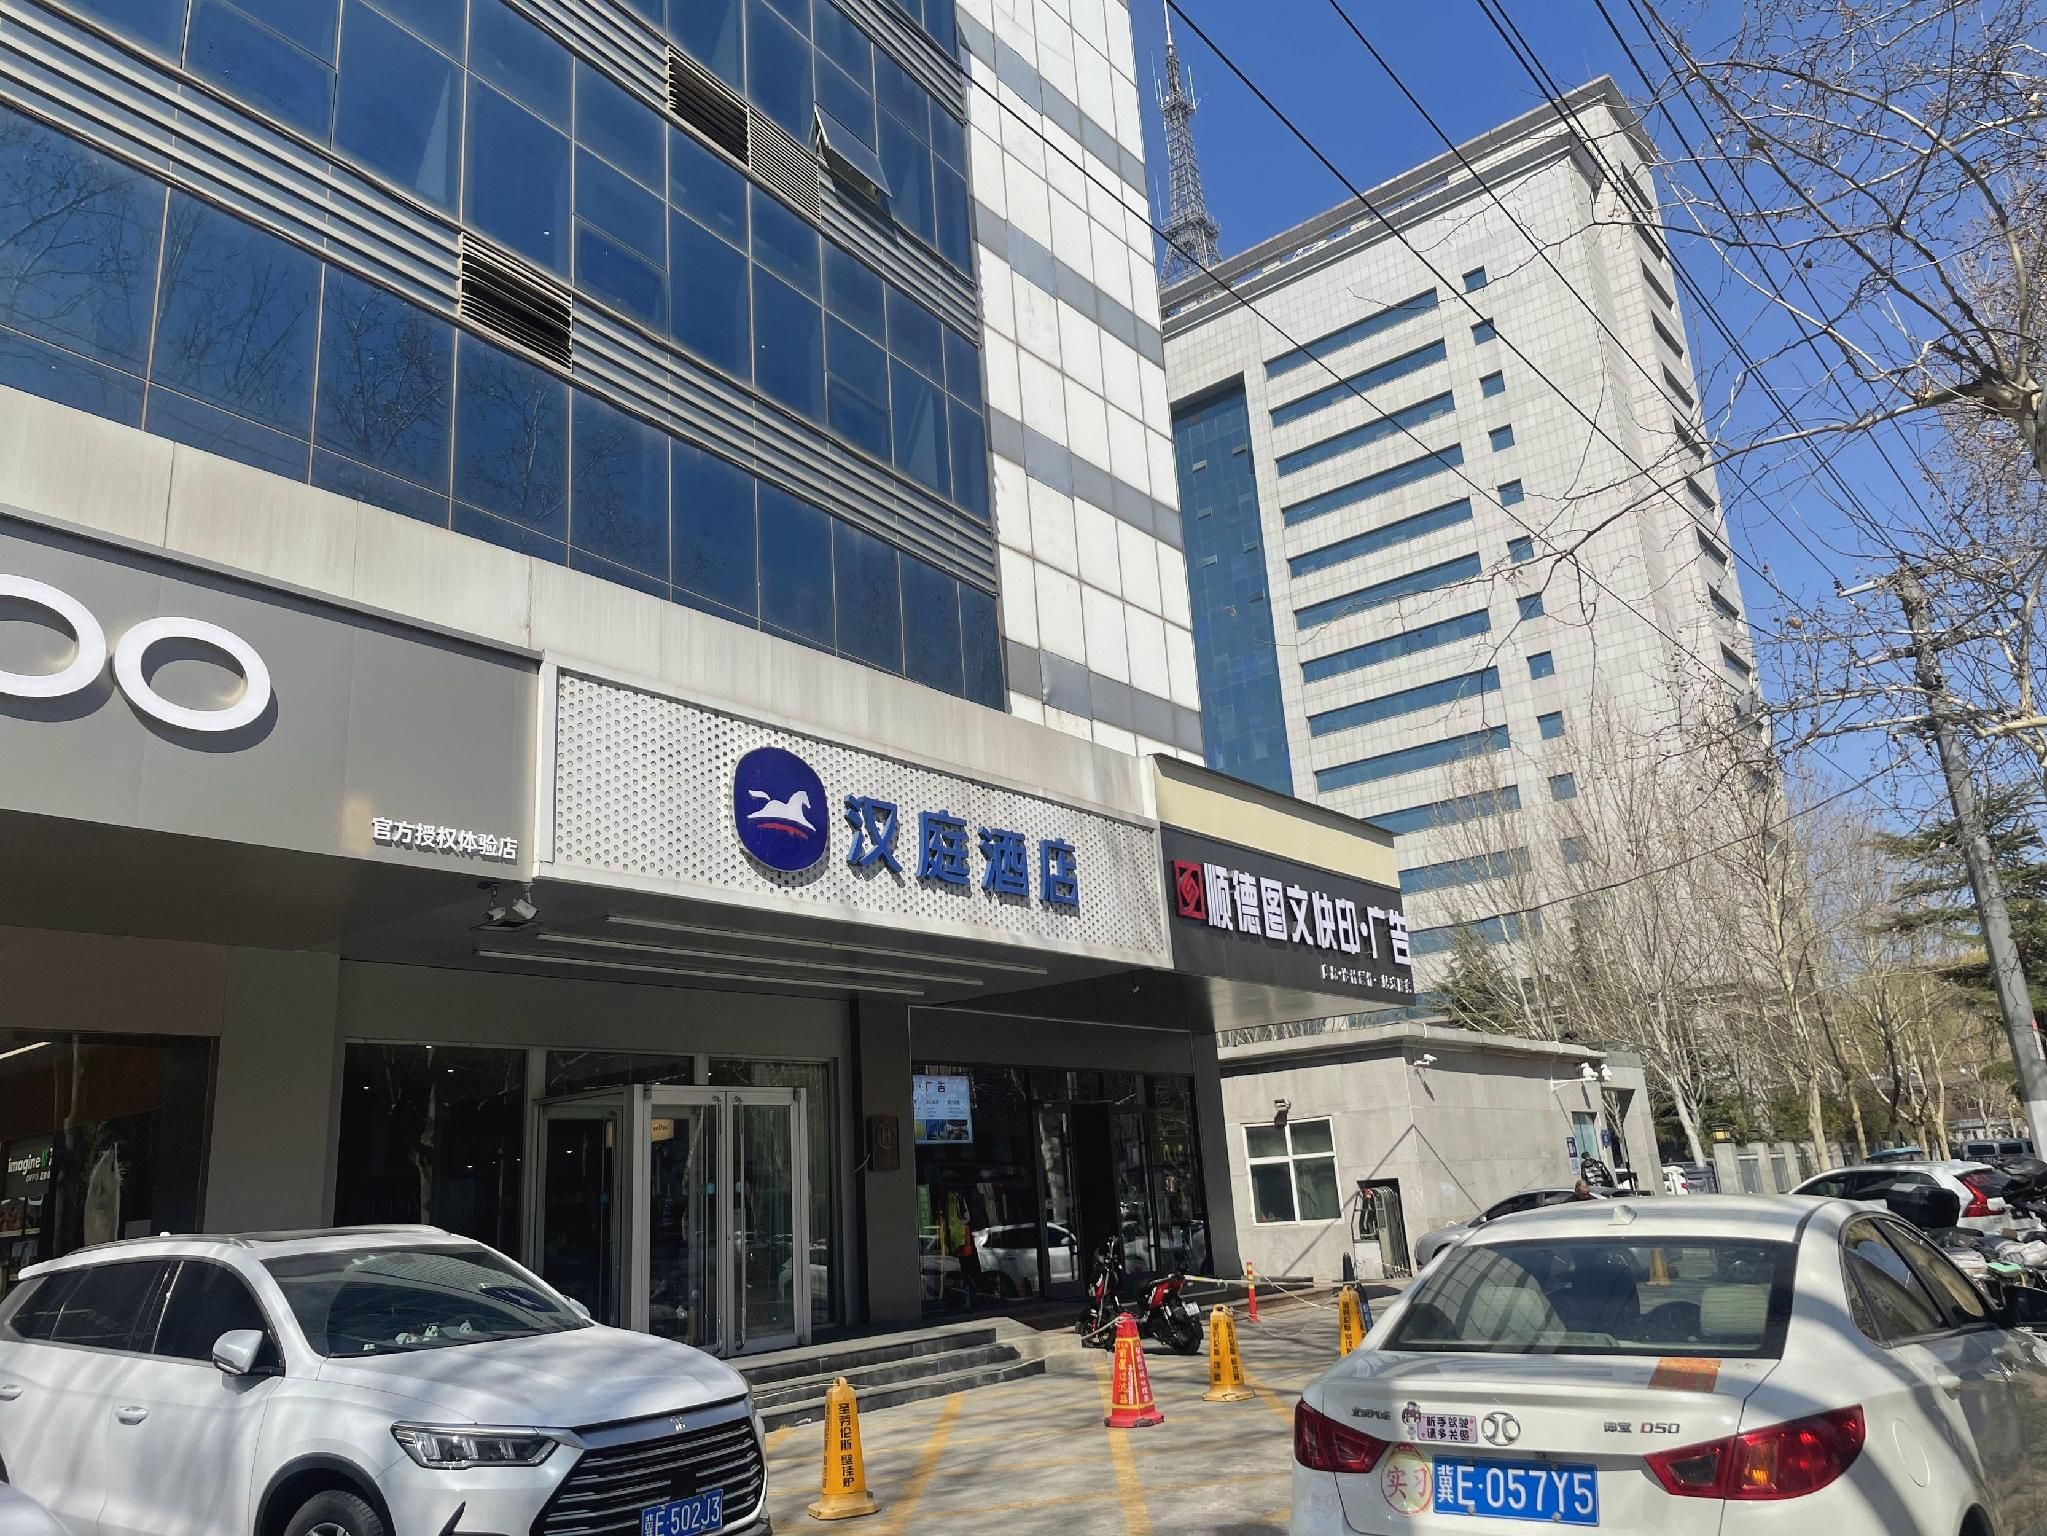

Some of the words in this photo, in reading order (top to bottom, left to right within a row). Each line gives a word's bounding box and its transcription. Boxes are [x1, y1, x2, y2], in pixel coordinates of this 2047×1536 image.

[371, 815, 519, 861] 官方授权体验店
[843, 793, 1080, 907] 汉庭酒店
[8, 1154, 41, 1176] imagine
[1426, 1415, 1470, 1428] 新手驾驶
[1639, 1421, 1681, 1434] D50
[1386, 1465, 1429, 1500] 实习
